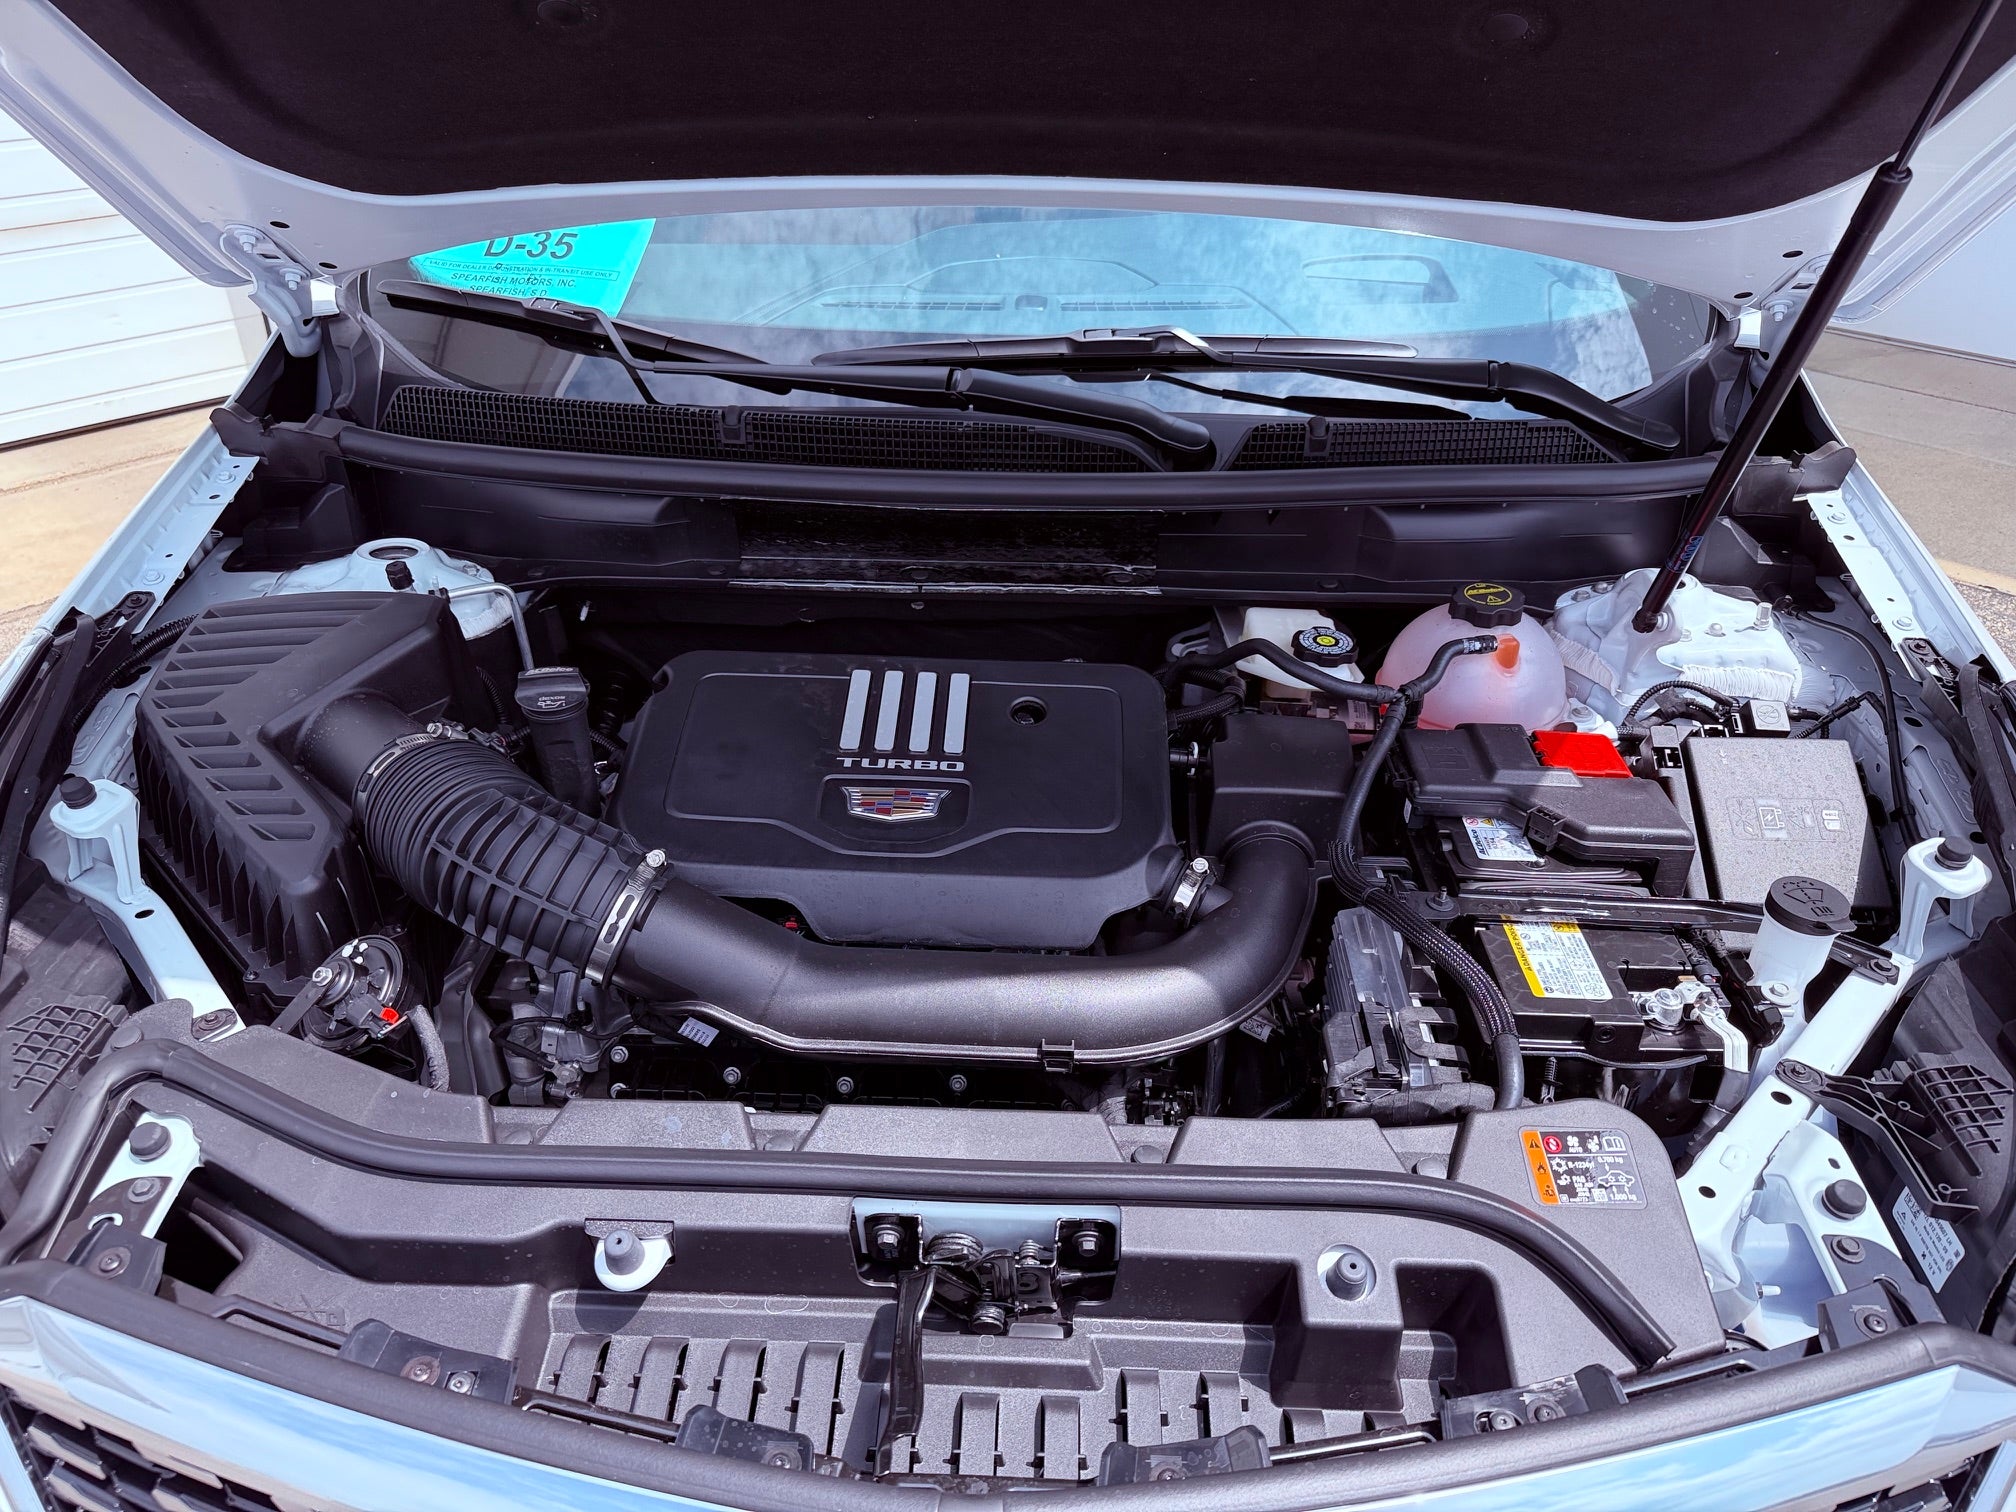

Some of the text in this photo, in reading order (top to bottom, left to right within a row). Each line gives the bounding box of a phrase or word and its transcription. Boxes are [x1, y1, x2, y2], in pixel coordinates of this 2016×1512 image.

[484, 232, 578, 260] D-35
[451, 272, 508, 284] SPEARFISH
[557, 278, 576, 288] INC.
[524, 666, 574, 676] ACDelco
[836, 757, 965, 772] TURBO
[1471, 829, 1486, 856] ACDelco
[1616, 1156, 1624, 1164] kg
